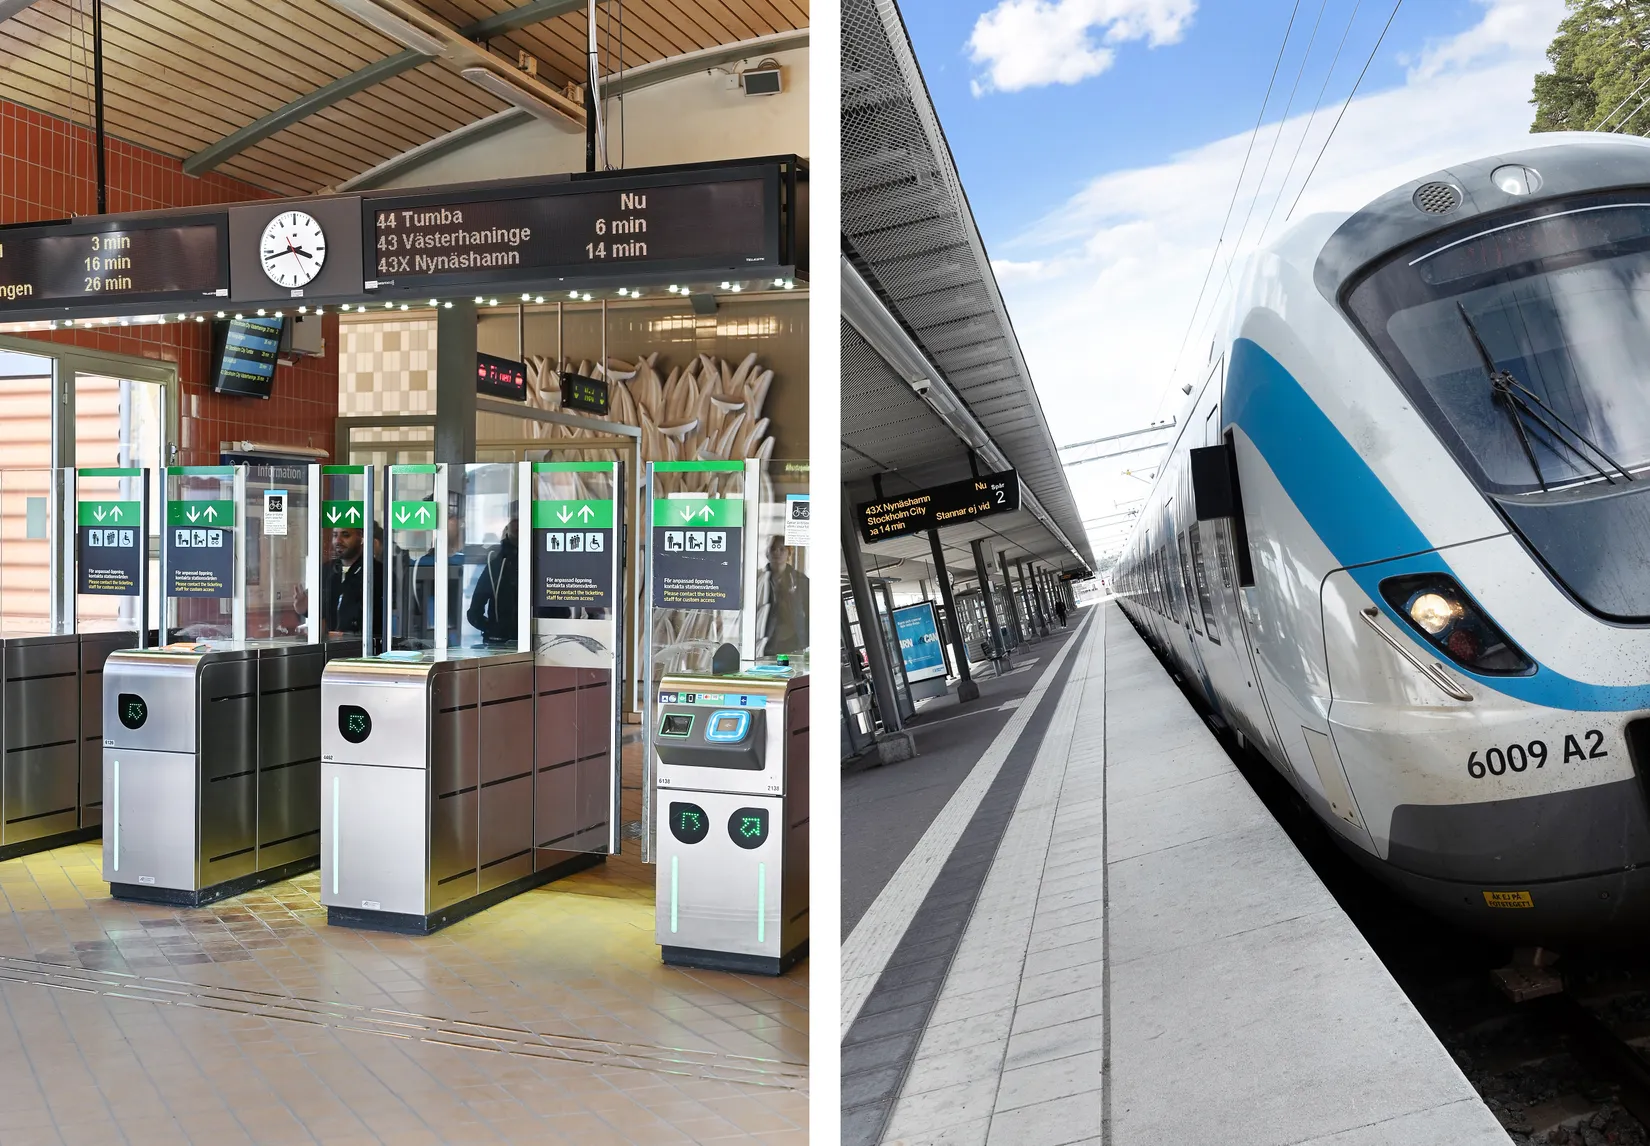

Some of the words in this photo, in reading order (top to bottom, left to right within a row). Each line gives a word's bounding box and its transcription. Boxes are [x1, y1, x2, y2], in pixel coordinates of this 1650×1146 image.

[620, 193, 646, 210] Nu
[377, 213, 396, 229] 44
[402, 208, 463, 228] Tumba
[595, 218, 606, 235] 6
[612, 217, 647, 234] min
[92, 236, 99, 250] 3
[104, 235, 130, 249] min
[377, 235, 398, 250] 43
[402, 227, 531, 250] Västerhaninge
[586, 242, 606, 259] 14
[612, 240, 647, 258] min
[84, 257, 100, 271] 16
[104, 255, 130, 270] min
[378, 256, 410, 273] 43X
[416, 251, 520, 274] Nynäshamn
[84, 277, 101, 291] 26
[105, 276, 131, 290] min
[258, 463, 301, 479] Information
[975, 482, 987, 490] Nu
[866, 505, 883, 515] 43X
[883, 495, 931, 512] Nynäshamn
[996, 490, 1006, 504] 2
[868, 511, 909, 525] Stockholm
[910, 507, 926, 516] City
[936, 508, 967, 520] Stannar
[968, 504, 977, 514] ej
[978, 501, 990, 511] vid
[891, 522, 906, 530] min
[1467, 740, 1548, 779] 6009
[1563, 729, 1608, 764] A2
